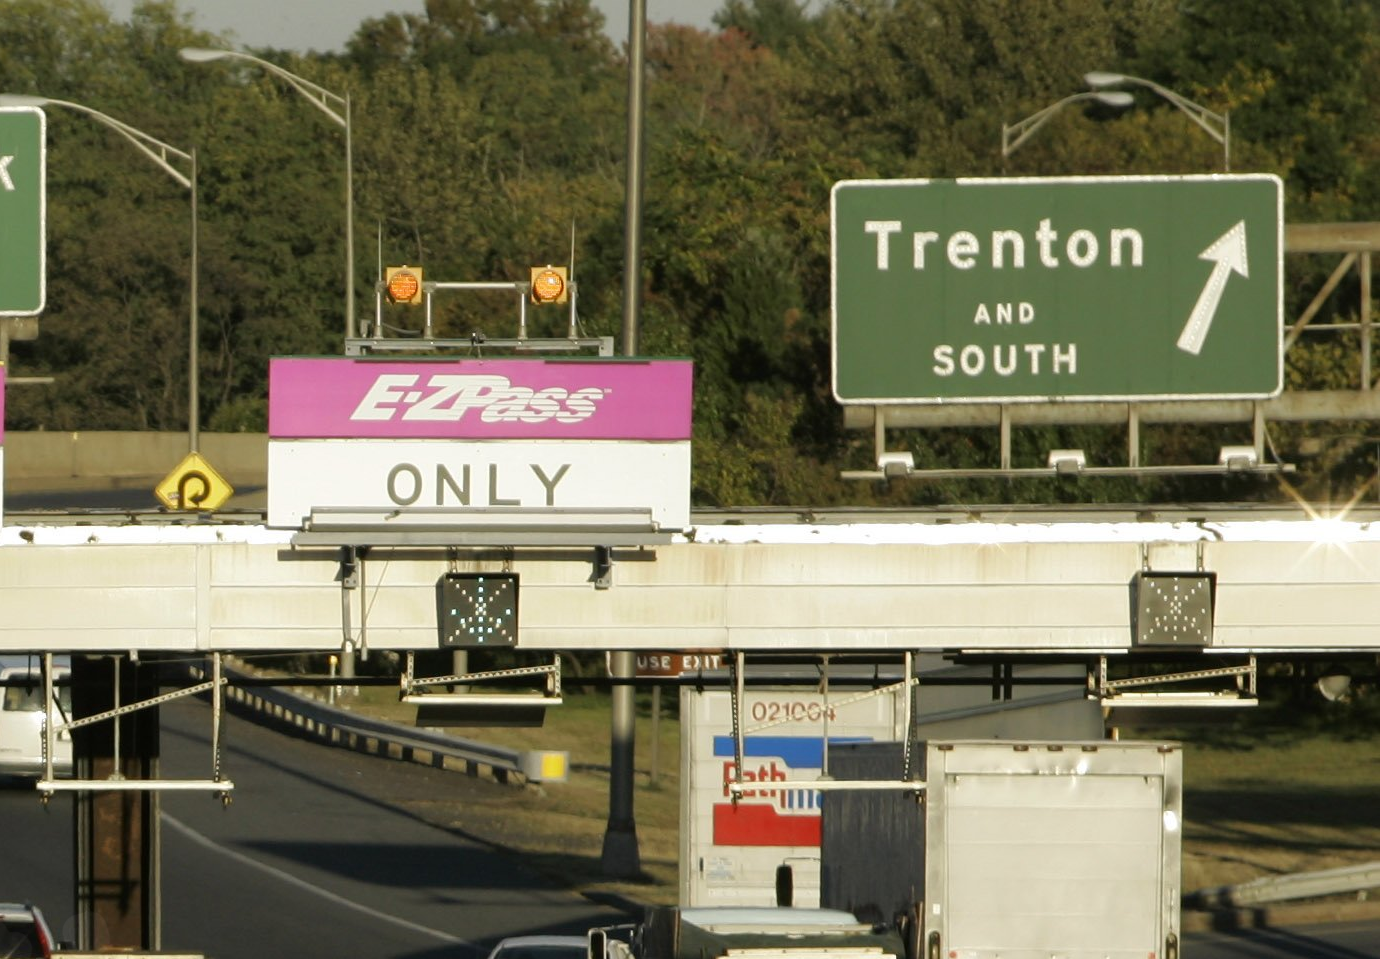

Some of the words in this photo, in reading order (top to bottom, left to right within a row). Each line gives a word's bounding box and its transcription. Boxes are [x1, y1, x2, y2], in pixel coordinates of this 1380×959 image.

[864, 218, 1144, 271] Trenton
[973, 302, 1035, 325] AND
[933, 344, 1077, 377] SOUTH
[387, 463, 572, 506] ONLY
[636, 656, 672, 670] USE
[682, 655, 720, 670] EXIT
